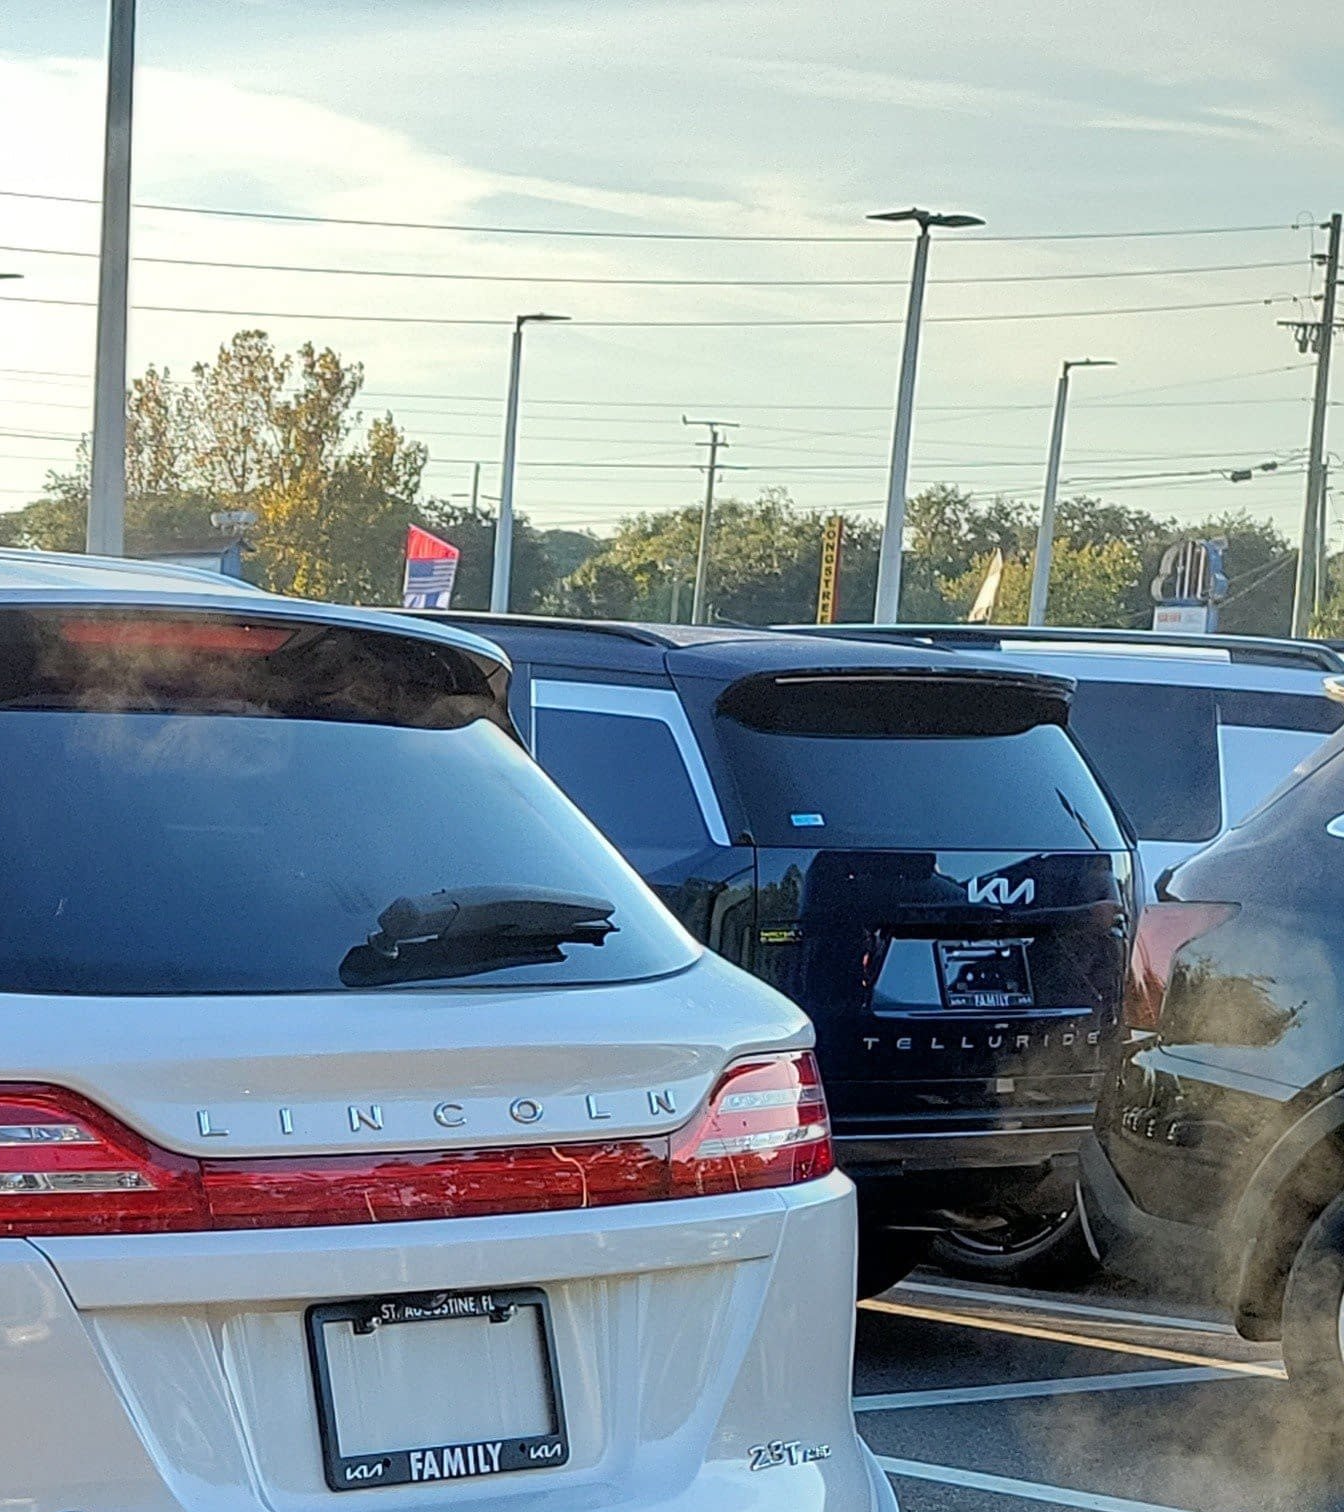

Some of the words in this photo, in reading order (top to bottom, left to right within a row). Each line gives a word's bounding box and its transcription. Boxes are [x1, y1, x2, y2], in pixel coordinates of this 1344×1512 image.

[967, 876, 1034, 904] KIA
[863, 1030, 1100, 1049] TELLURIDE
[197, 1089, 676, 1137] LINCOLN
[380, 1303, 400, 1320] ST.
[481, 1294, 495, 1311] FL
[345, 1461, 383, 1481] KIA
[409, 1442, 503, 1481] FAMILY
[529, 1443, 561, 1460] KIA
